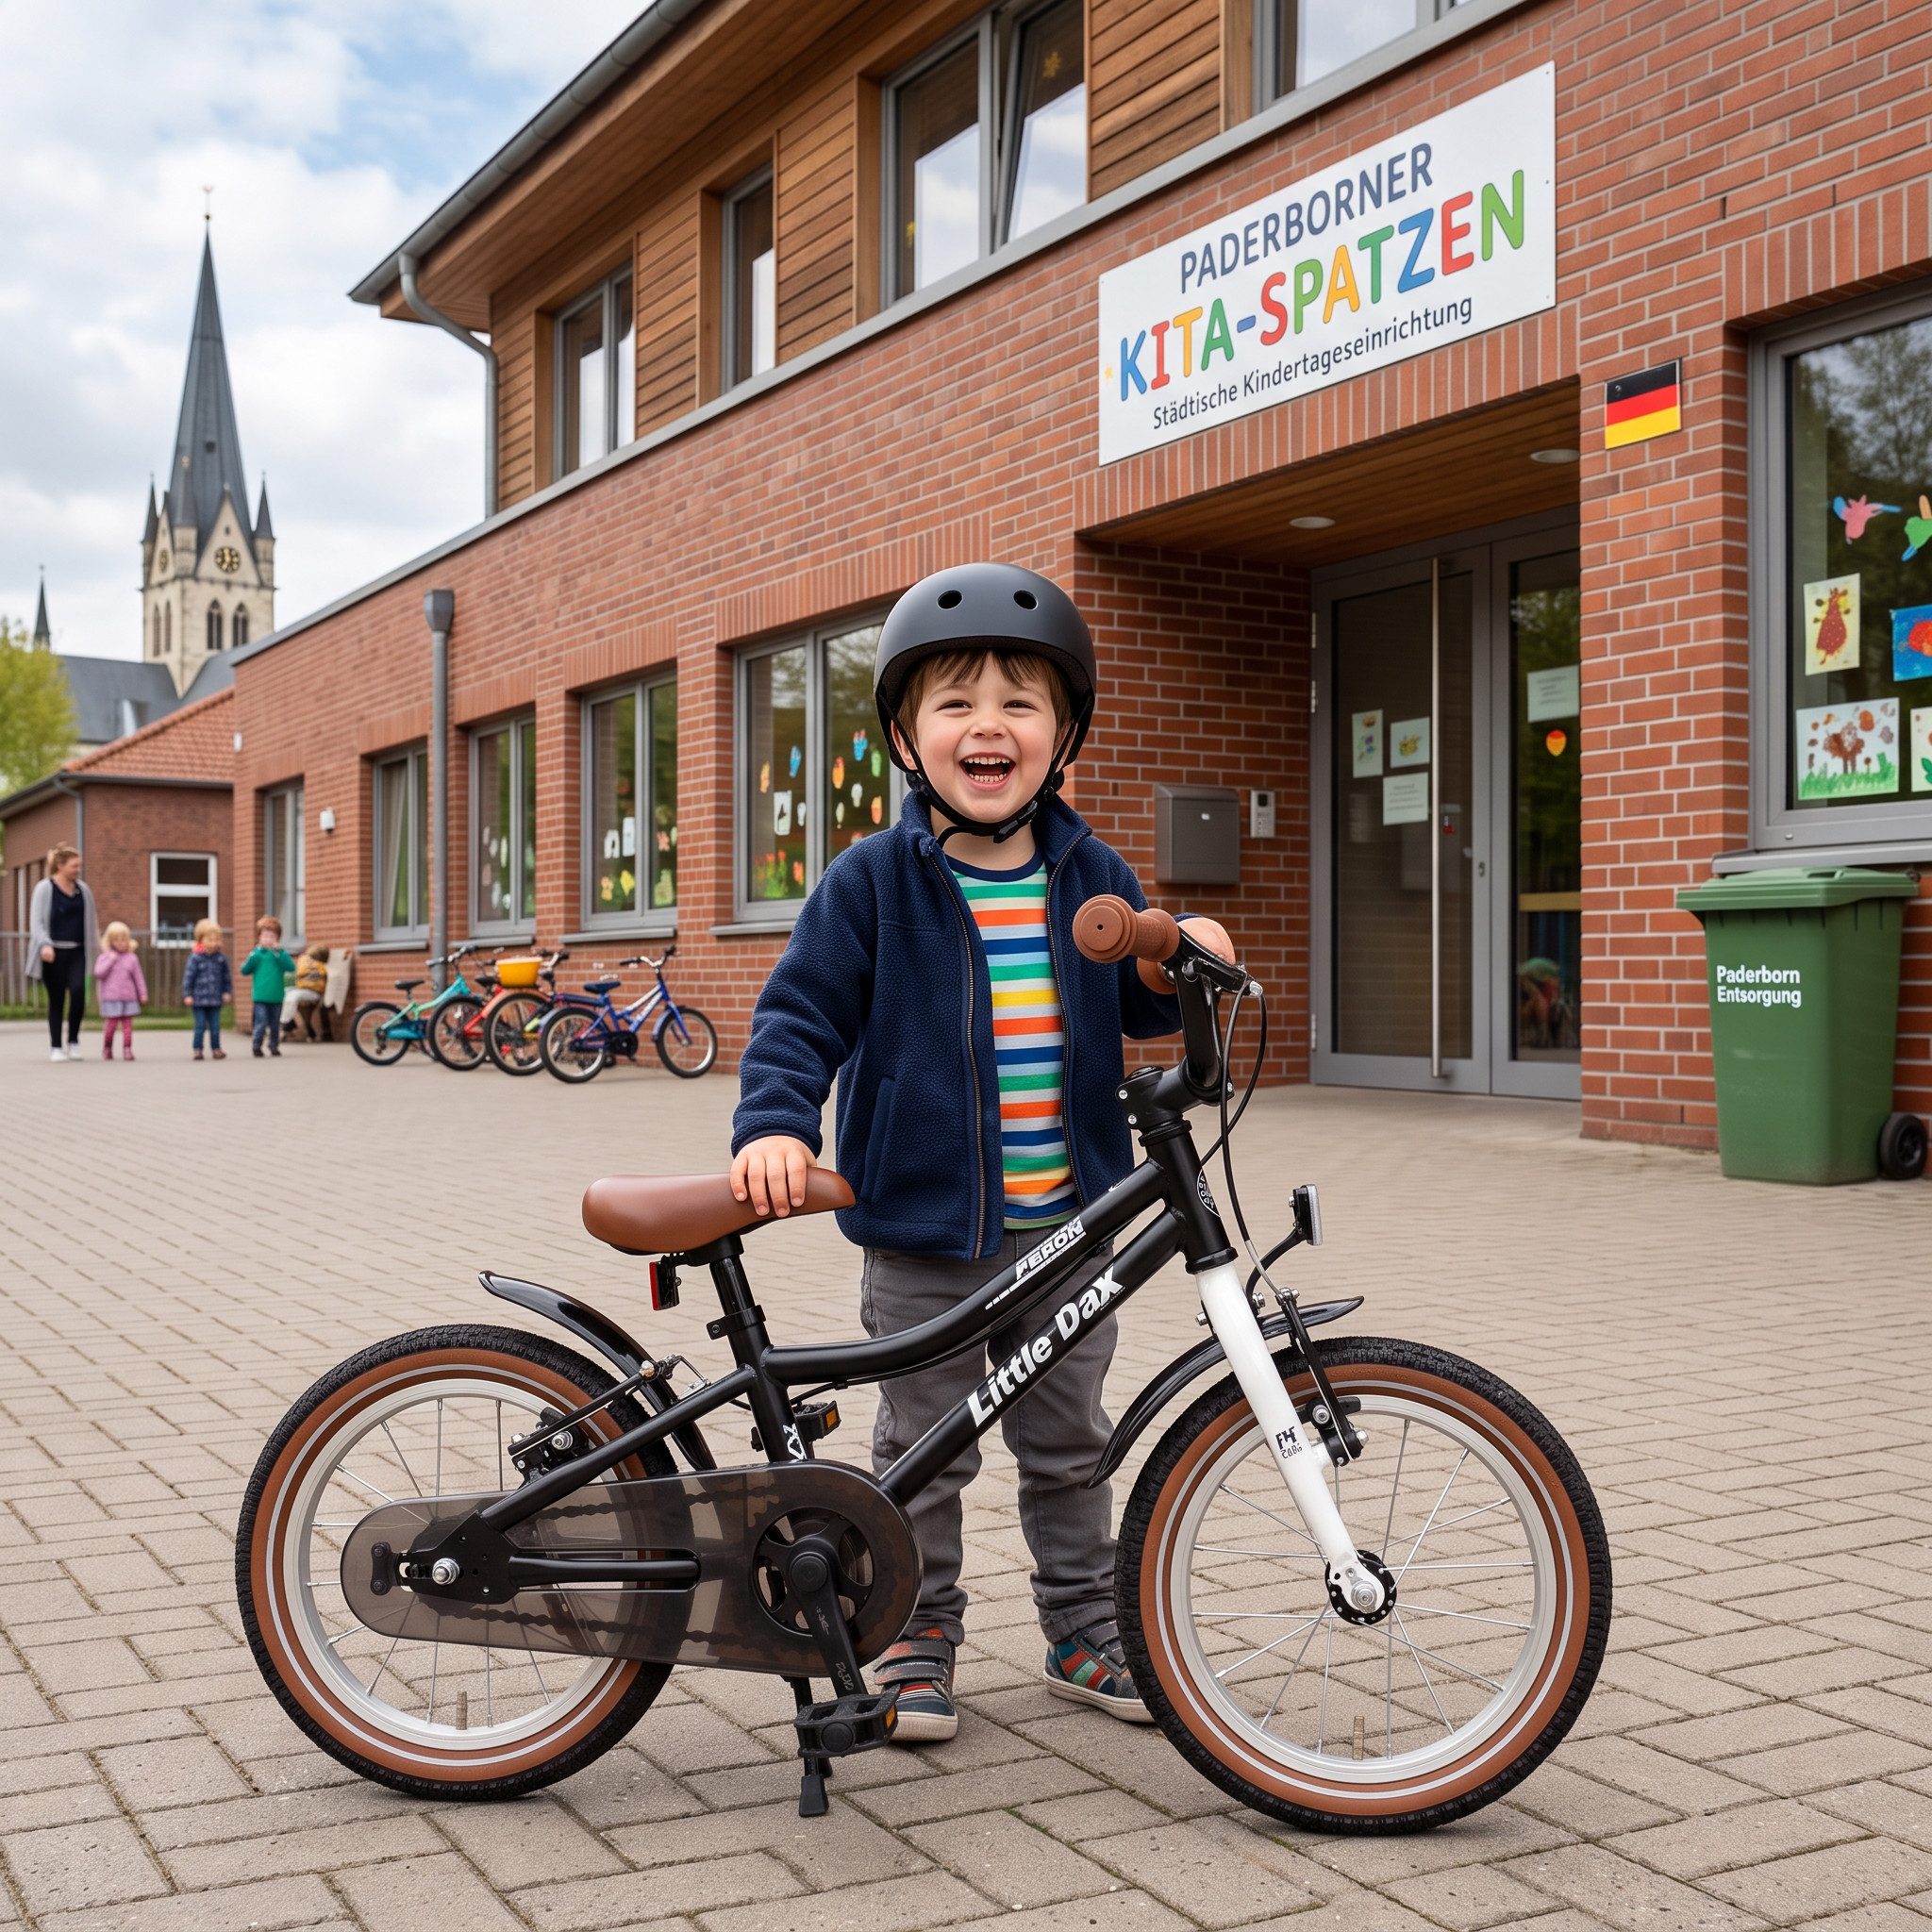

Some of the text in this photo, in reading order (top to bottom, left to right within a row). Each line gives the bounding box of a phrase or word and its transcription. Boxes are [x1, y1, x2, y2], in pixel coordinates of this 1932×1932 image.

[1120, 169, 1524, 402] KITA-SPATZEN
[1180, 142, 1433, 293] PADERBORNER
[1153, 297, 1473, 430] Städtische Kindertageseinrichtung
[1716, 964, 1801, 984] Paderborn
[1717, 985, 1802, 1008] Entsorgung
[967, 1266, 1124, 1428] Little Dax
